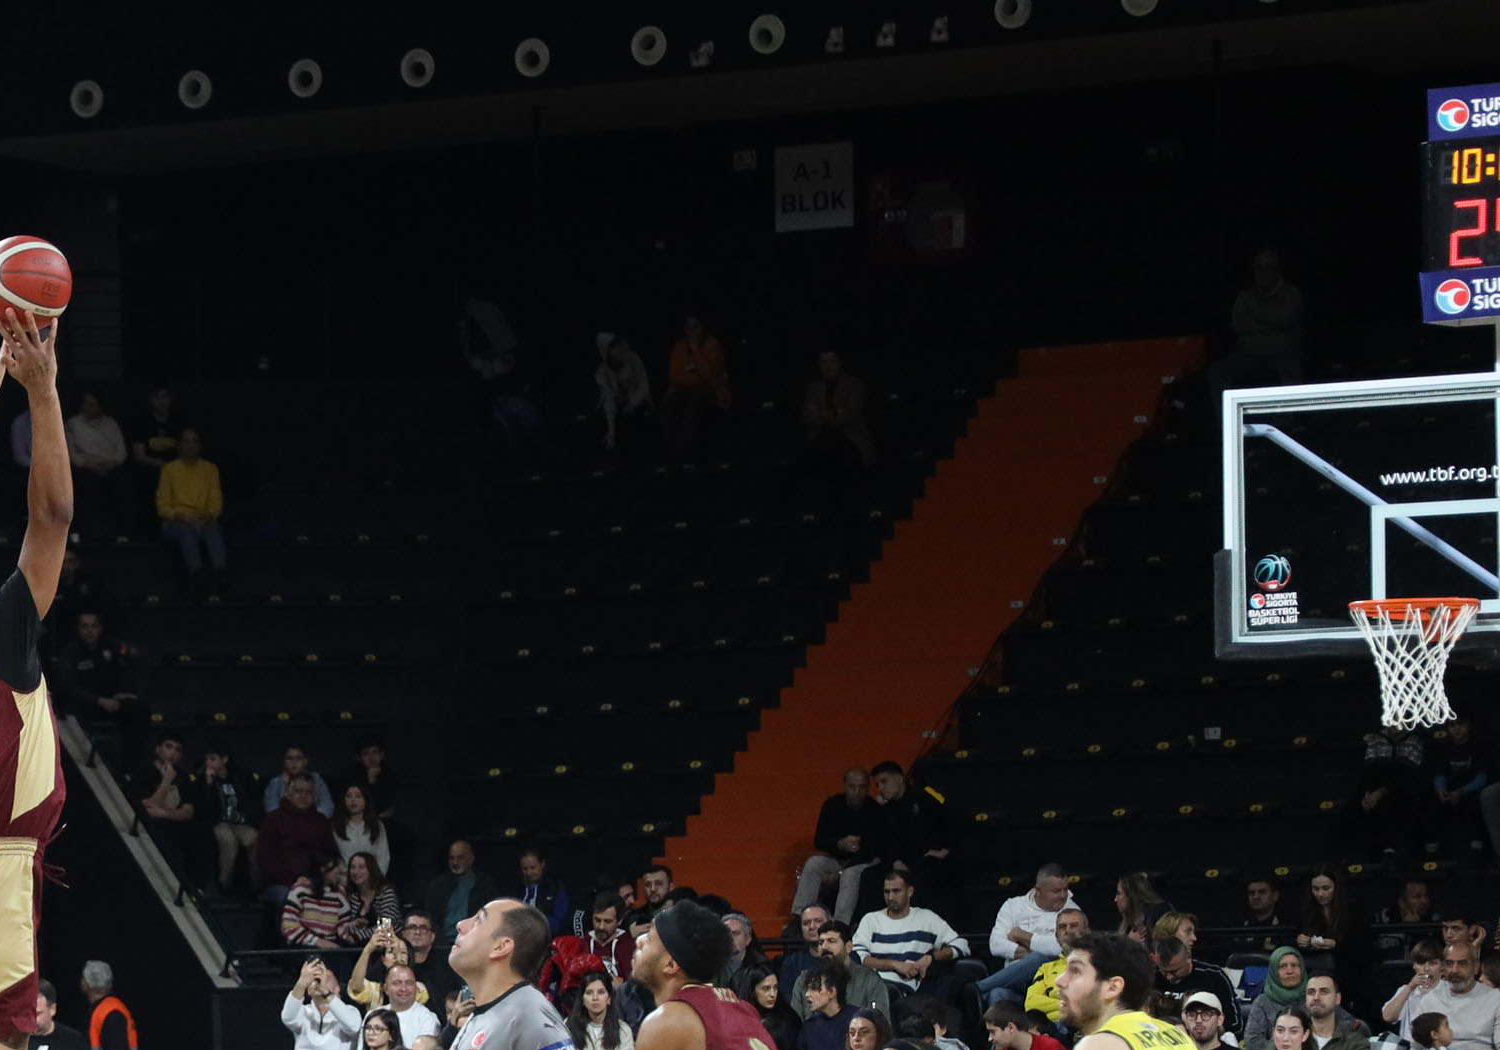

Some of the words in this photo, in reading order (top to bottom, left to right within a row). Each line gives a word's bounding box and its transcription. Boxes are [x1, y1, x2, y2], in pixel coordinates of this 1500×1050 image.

[794, 160, 833, 183] A-1
[1451, 147, 1500, 185] 10:
[781, 190, 847, 215] BLOK
